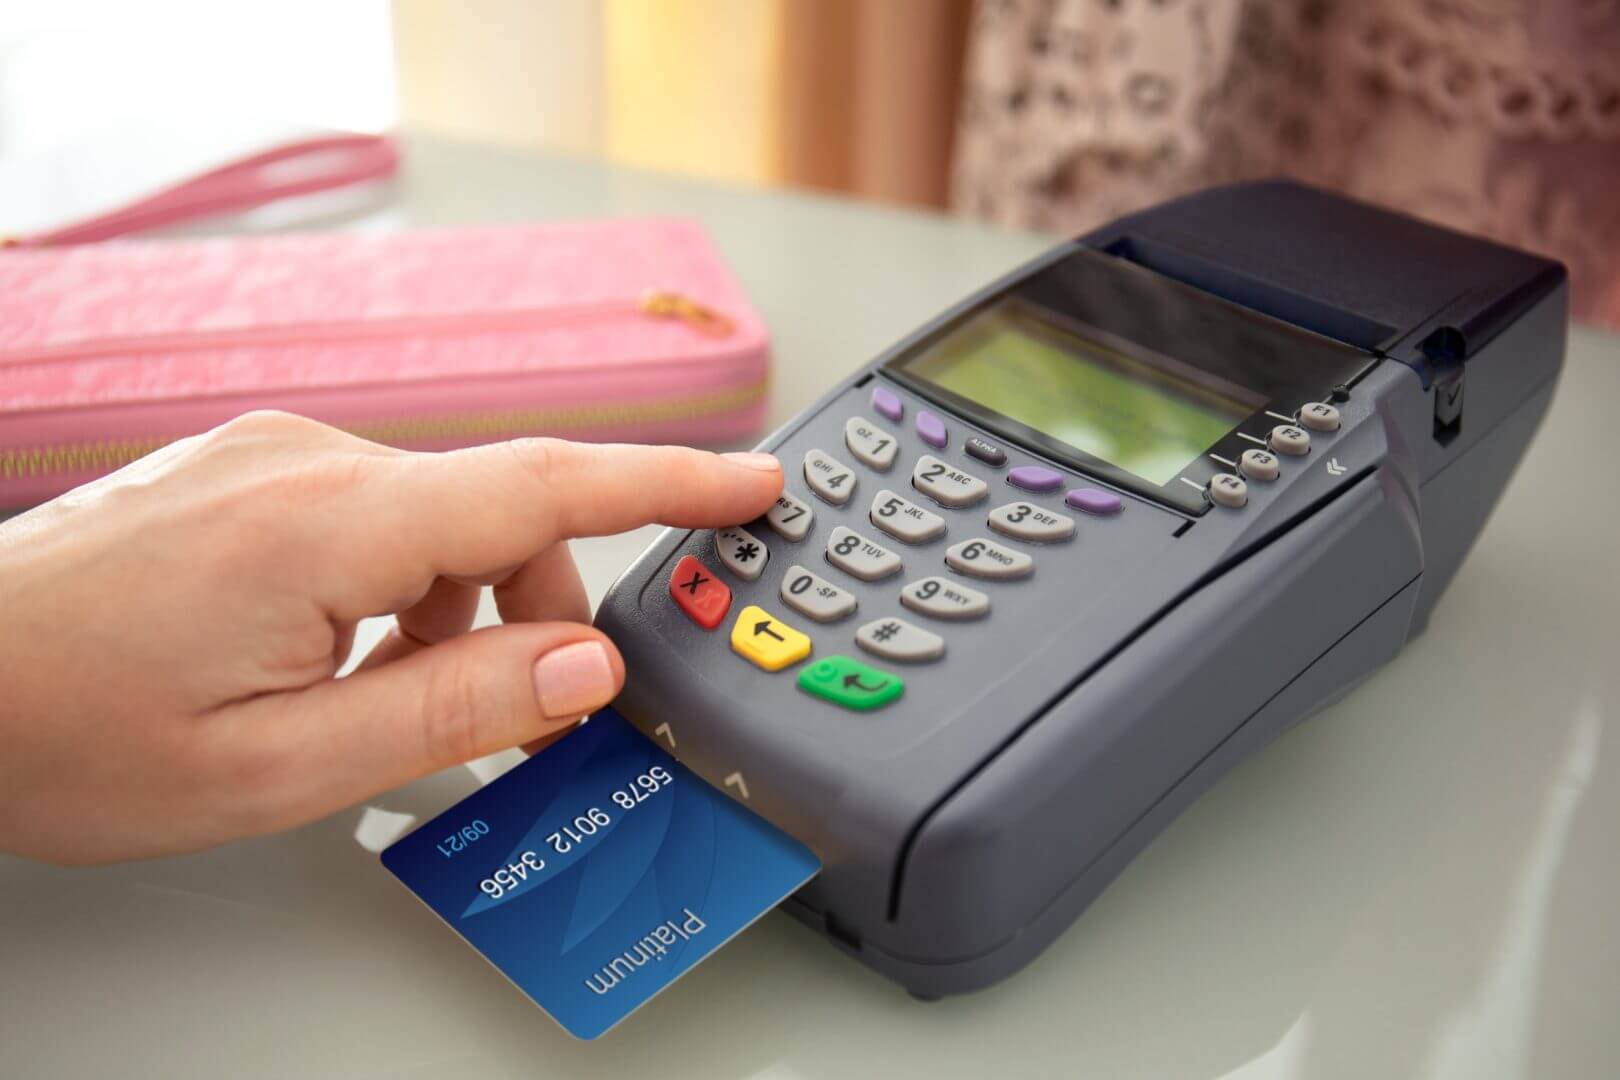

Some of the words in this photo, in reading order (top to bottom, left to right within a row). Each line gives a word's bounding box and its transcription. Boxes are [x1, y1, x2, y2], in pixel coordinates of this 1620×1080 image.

[1312, 404, 1330, 417] F1
[971, 437, 998, 453] ALPHA
[1282, 428, 1302, 440] F2
[872, 439, 890, 455] 1
[1252, 451, 1272, 464] F3
[812, 459, 833, 474] GHI
[828, 473, 849, 489] 4
[919, 464, 946, 482] 2
[946, 471, 971, 486] ABC
[1220, 476, 1240, 489] F4
[781, 506, 806, 523] 7
[878, 498, 904, 517] 5
[904, 505, 925, 521] JKL
[1006, 505, 1031, 524] 3
[1033, 512, 1057, 526] DEF
[833, 536, 860, 557] 8
[861, 543, 886, 559] TUV
[960, 541, 987, 561] 6
[986, 549, 1014, 566] MNO
[790, 575, 813, 595] 0
[915, 581, 941, 599] 9
[943, 588, 971, 604] WXY
[611, 765, 674, 810] 5678
[436, 819, 491, 859] 09/21
[545, 806, 611, 855] 9012
[478, 850, 547, 899] 3456
[584, 907, 707, 996] Platinum
